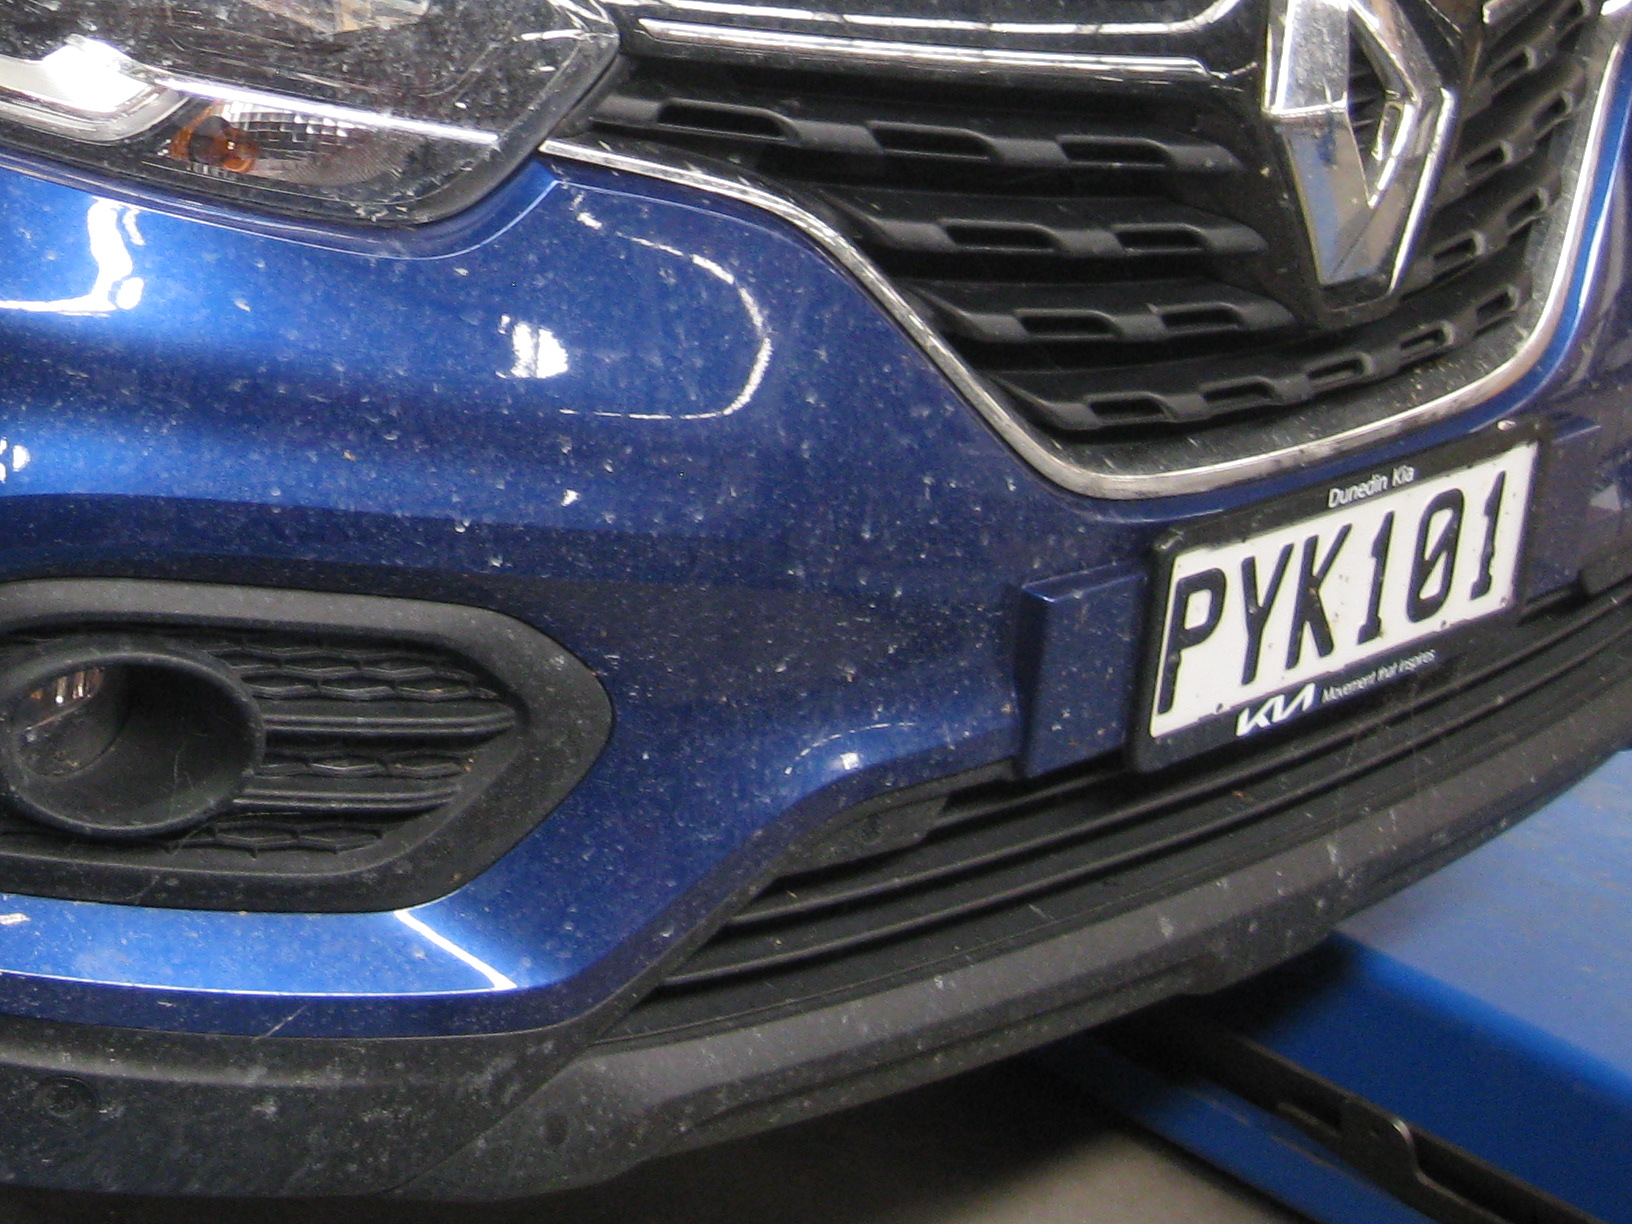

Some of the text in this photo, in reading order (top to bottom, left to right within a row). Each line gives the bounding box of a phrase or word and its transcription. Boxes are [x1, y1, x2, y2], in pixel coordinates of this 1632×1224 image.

[1328, 465, 1415, 508] Dunedin Kia
[1157, 470, 1507, 716] PYK101
[1321, 670, 1377, 704] Movement
